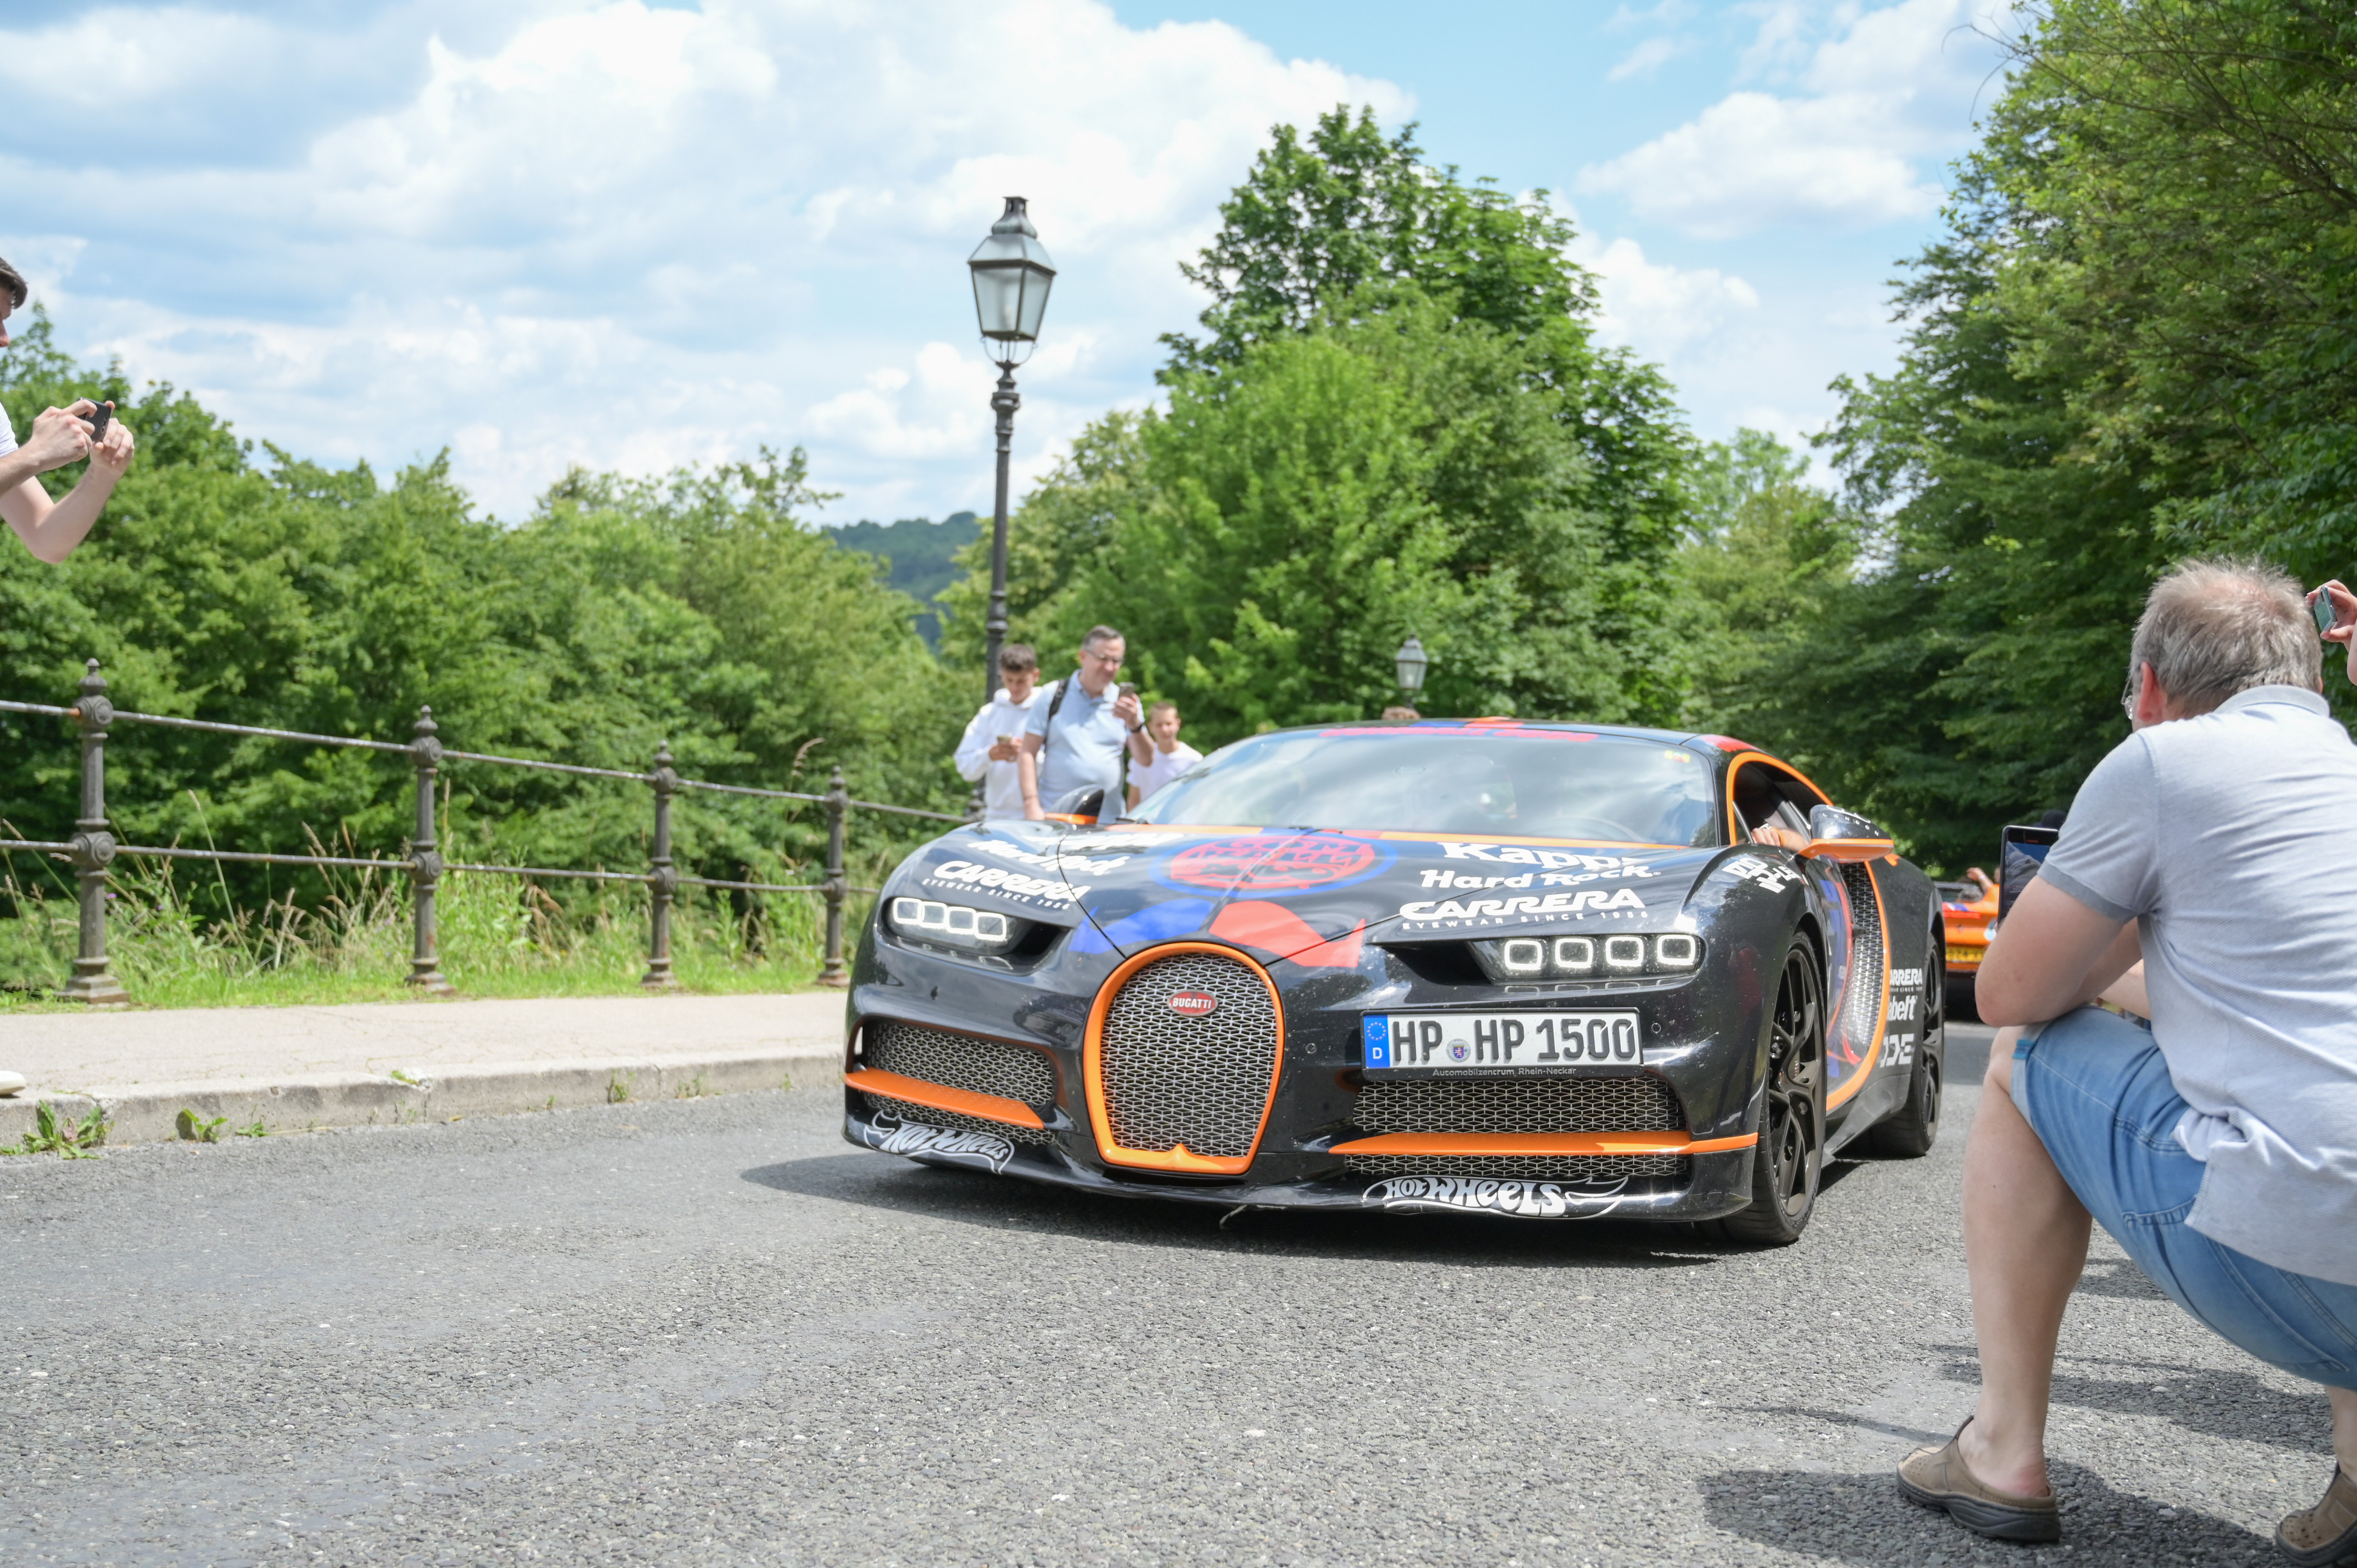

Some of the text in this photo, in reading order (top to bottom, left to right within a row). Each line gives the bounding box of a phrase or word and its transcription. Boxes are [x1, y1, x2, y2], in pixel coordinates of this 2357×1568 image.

[1436, 842, 1647, 870] Kapp
[933, 860, 1091, 902] CARRERA
[1420, 869, 1534, 888] Hard
[922, 878, 1070, 910] EYEWEAR SINCE 1956
[1399, 888, 1646, 921] CARRERA
[1402, 911, 1648, 930] EYEWEAR SINCE 1956
[1889, 968, 1923, 986] ARRERA
[1172, 997, 1212, 1009] BUGATTI
[1886, 994, 1916, 1021] abelt
[1392, 1020, 1443, 1061] HP
[1474, 1019, 1525, 1060] HP
[1536, 1018, 1636, 1059] 1500
[1372, 1047, 1383, 1060] D
[1432, 1067, 1577, 1077] Automobilzentrum Rhein-Neckar
